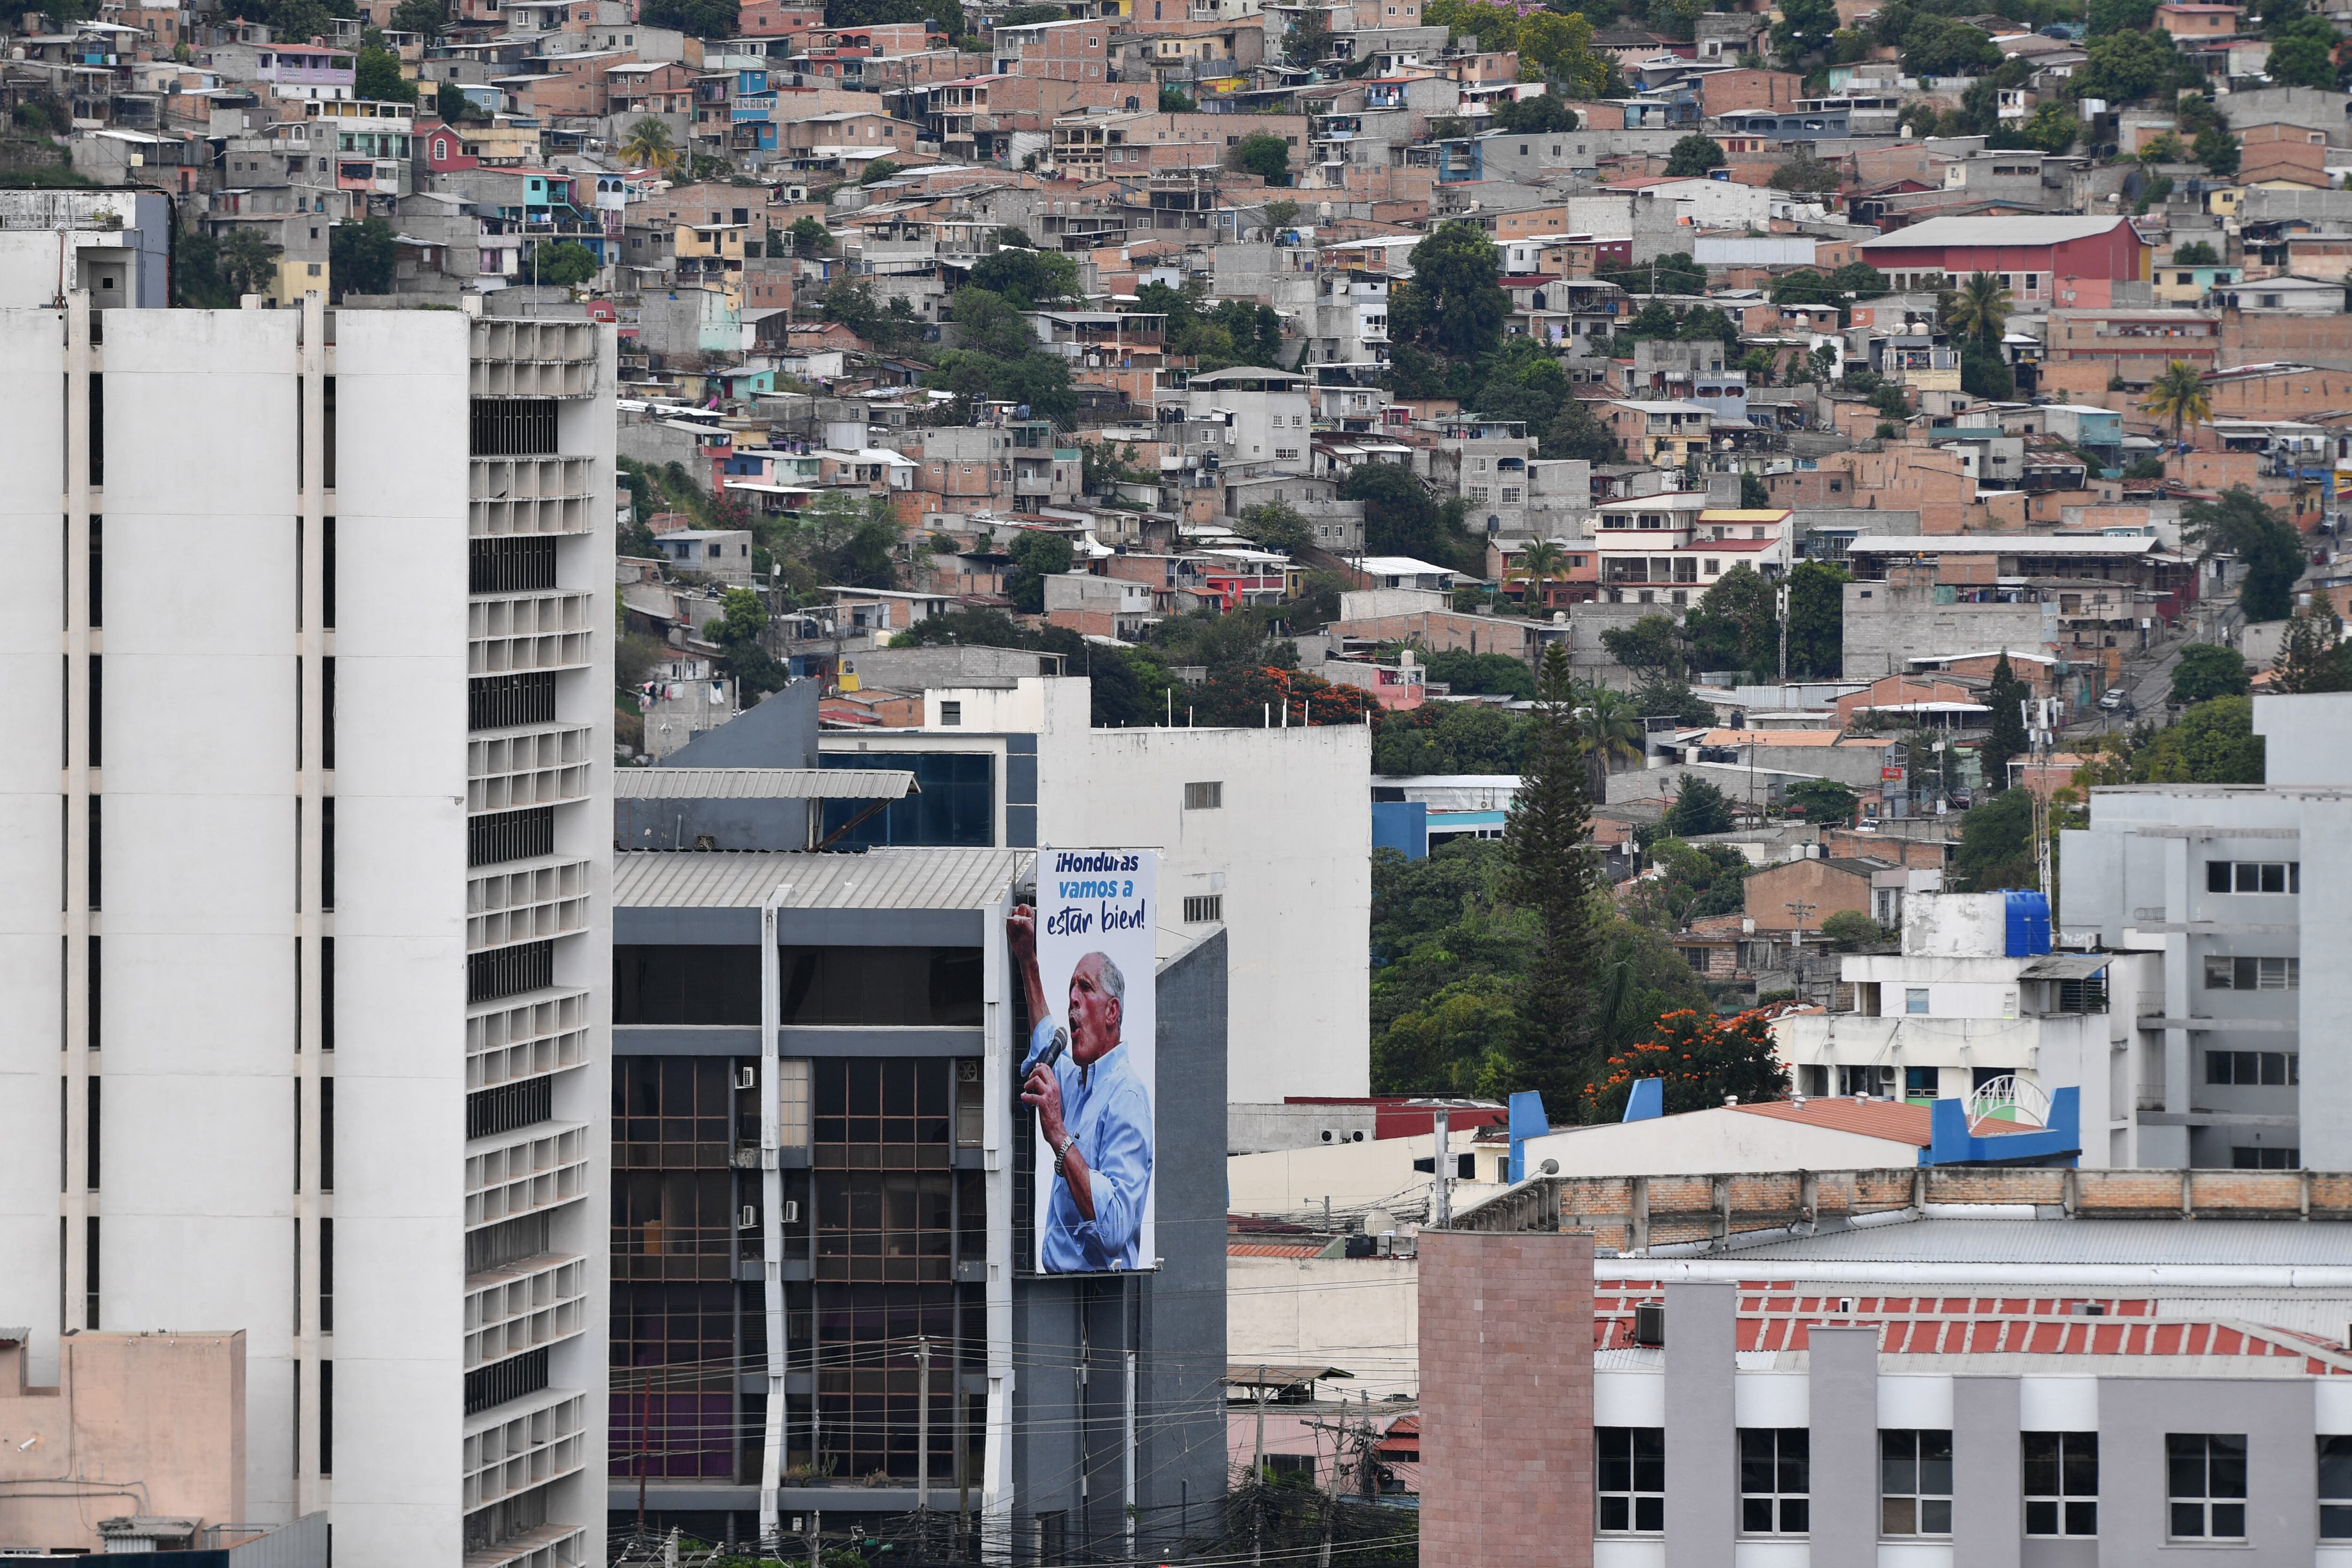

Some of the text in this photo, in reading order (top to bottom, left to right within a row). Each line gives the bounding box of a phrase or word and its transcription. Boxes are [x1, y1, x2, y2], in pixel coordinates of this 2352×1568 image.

[1059, 880, 1133, 898] vamos a
[1047, 898, 1145, 936] estar bien!
